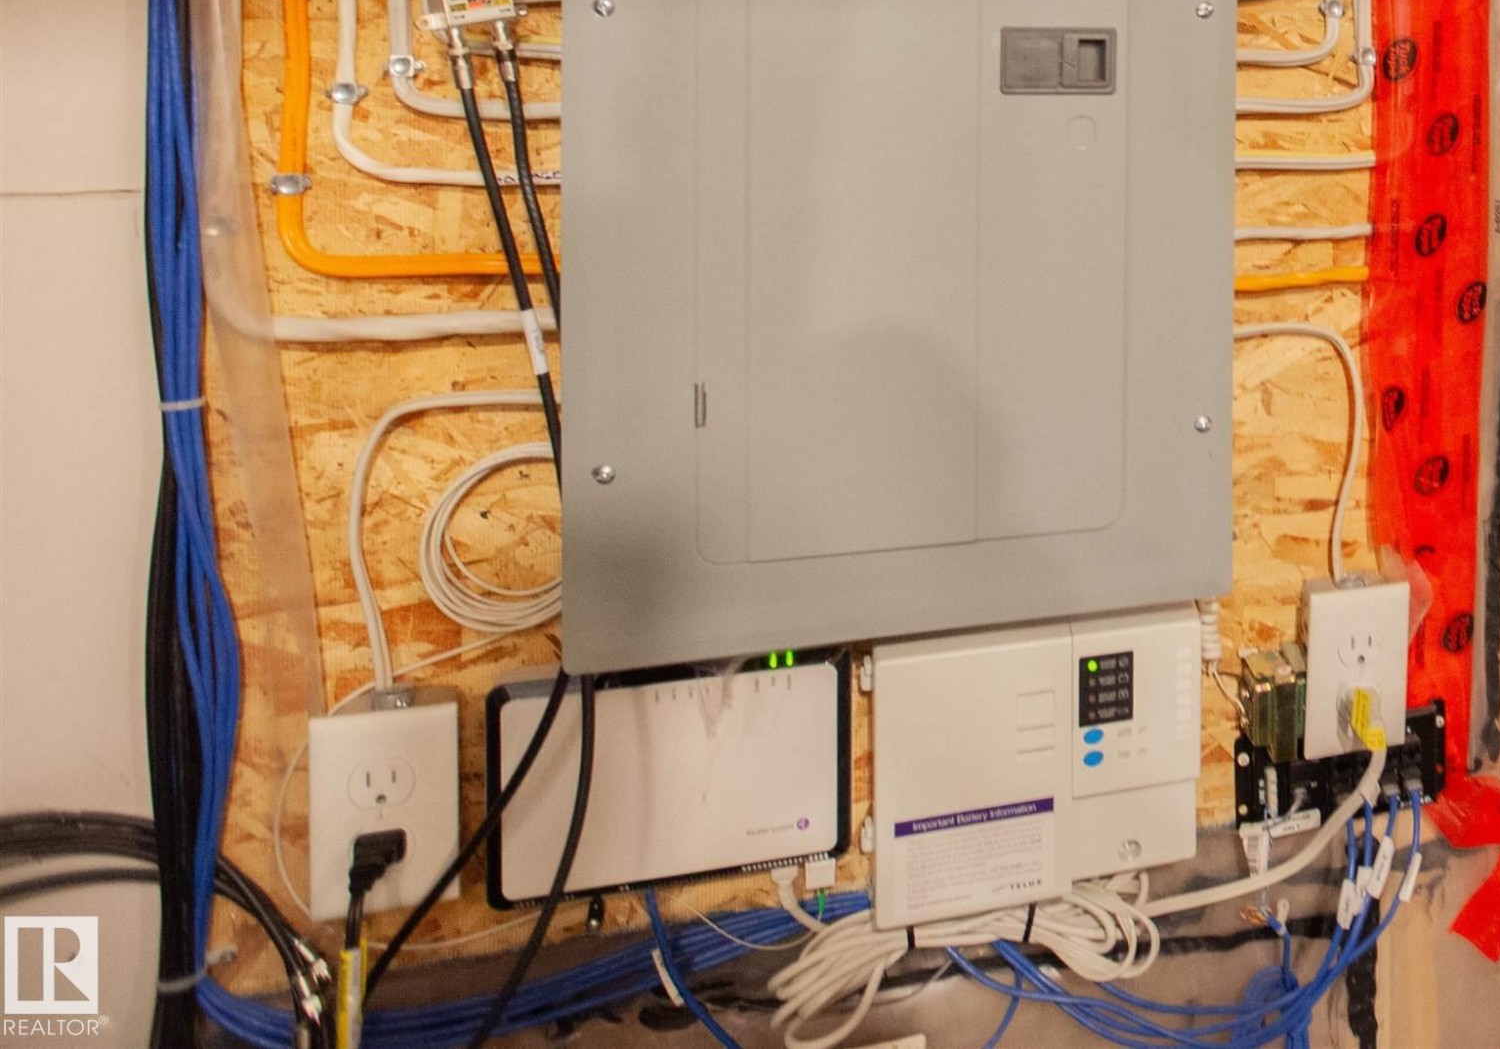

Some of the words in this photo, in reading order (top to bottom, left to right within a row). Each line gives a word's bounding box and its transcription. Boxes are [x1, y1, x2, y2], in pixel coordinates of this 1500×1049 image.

[1398, 42, 1411, 74] Tuck
[912, 816, 955, 833] Important
[956, 809, 988, 826] Battery
[989, 803, 1037, 820] Information
